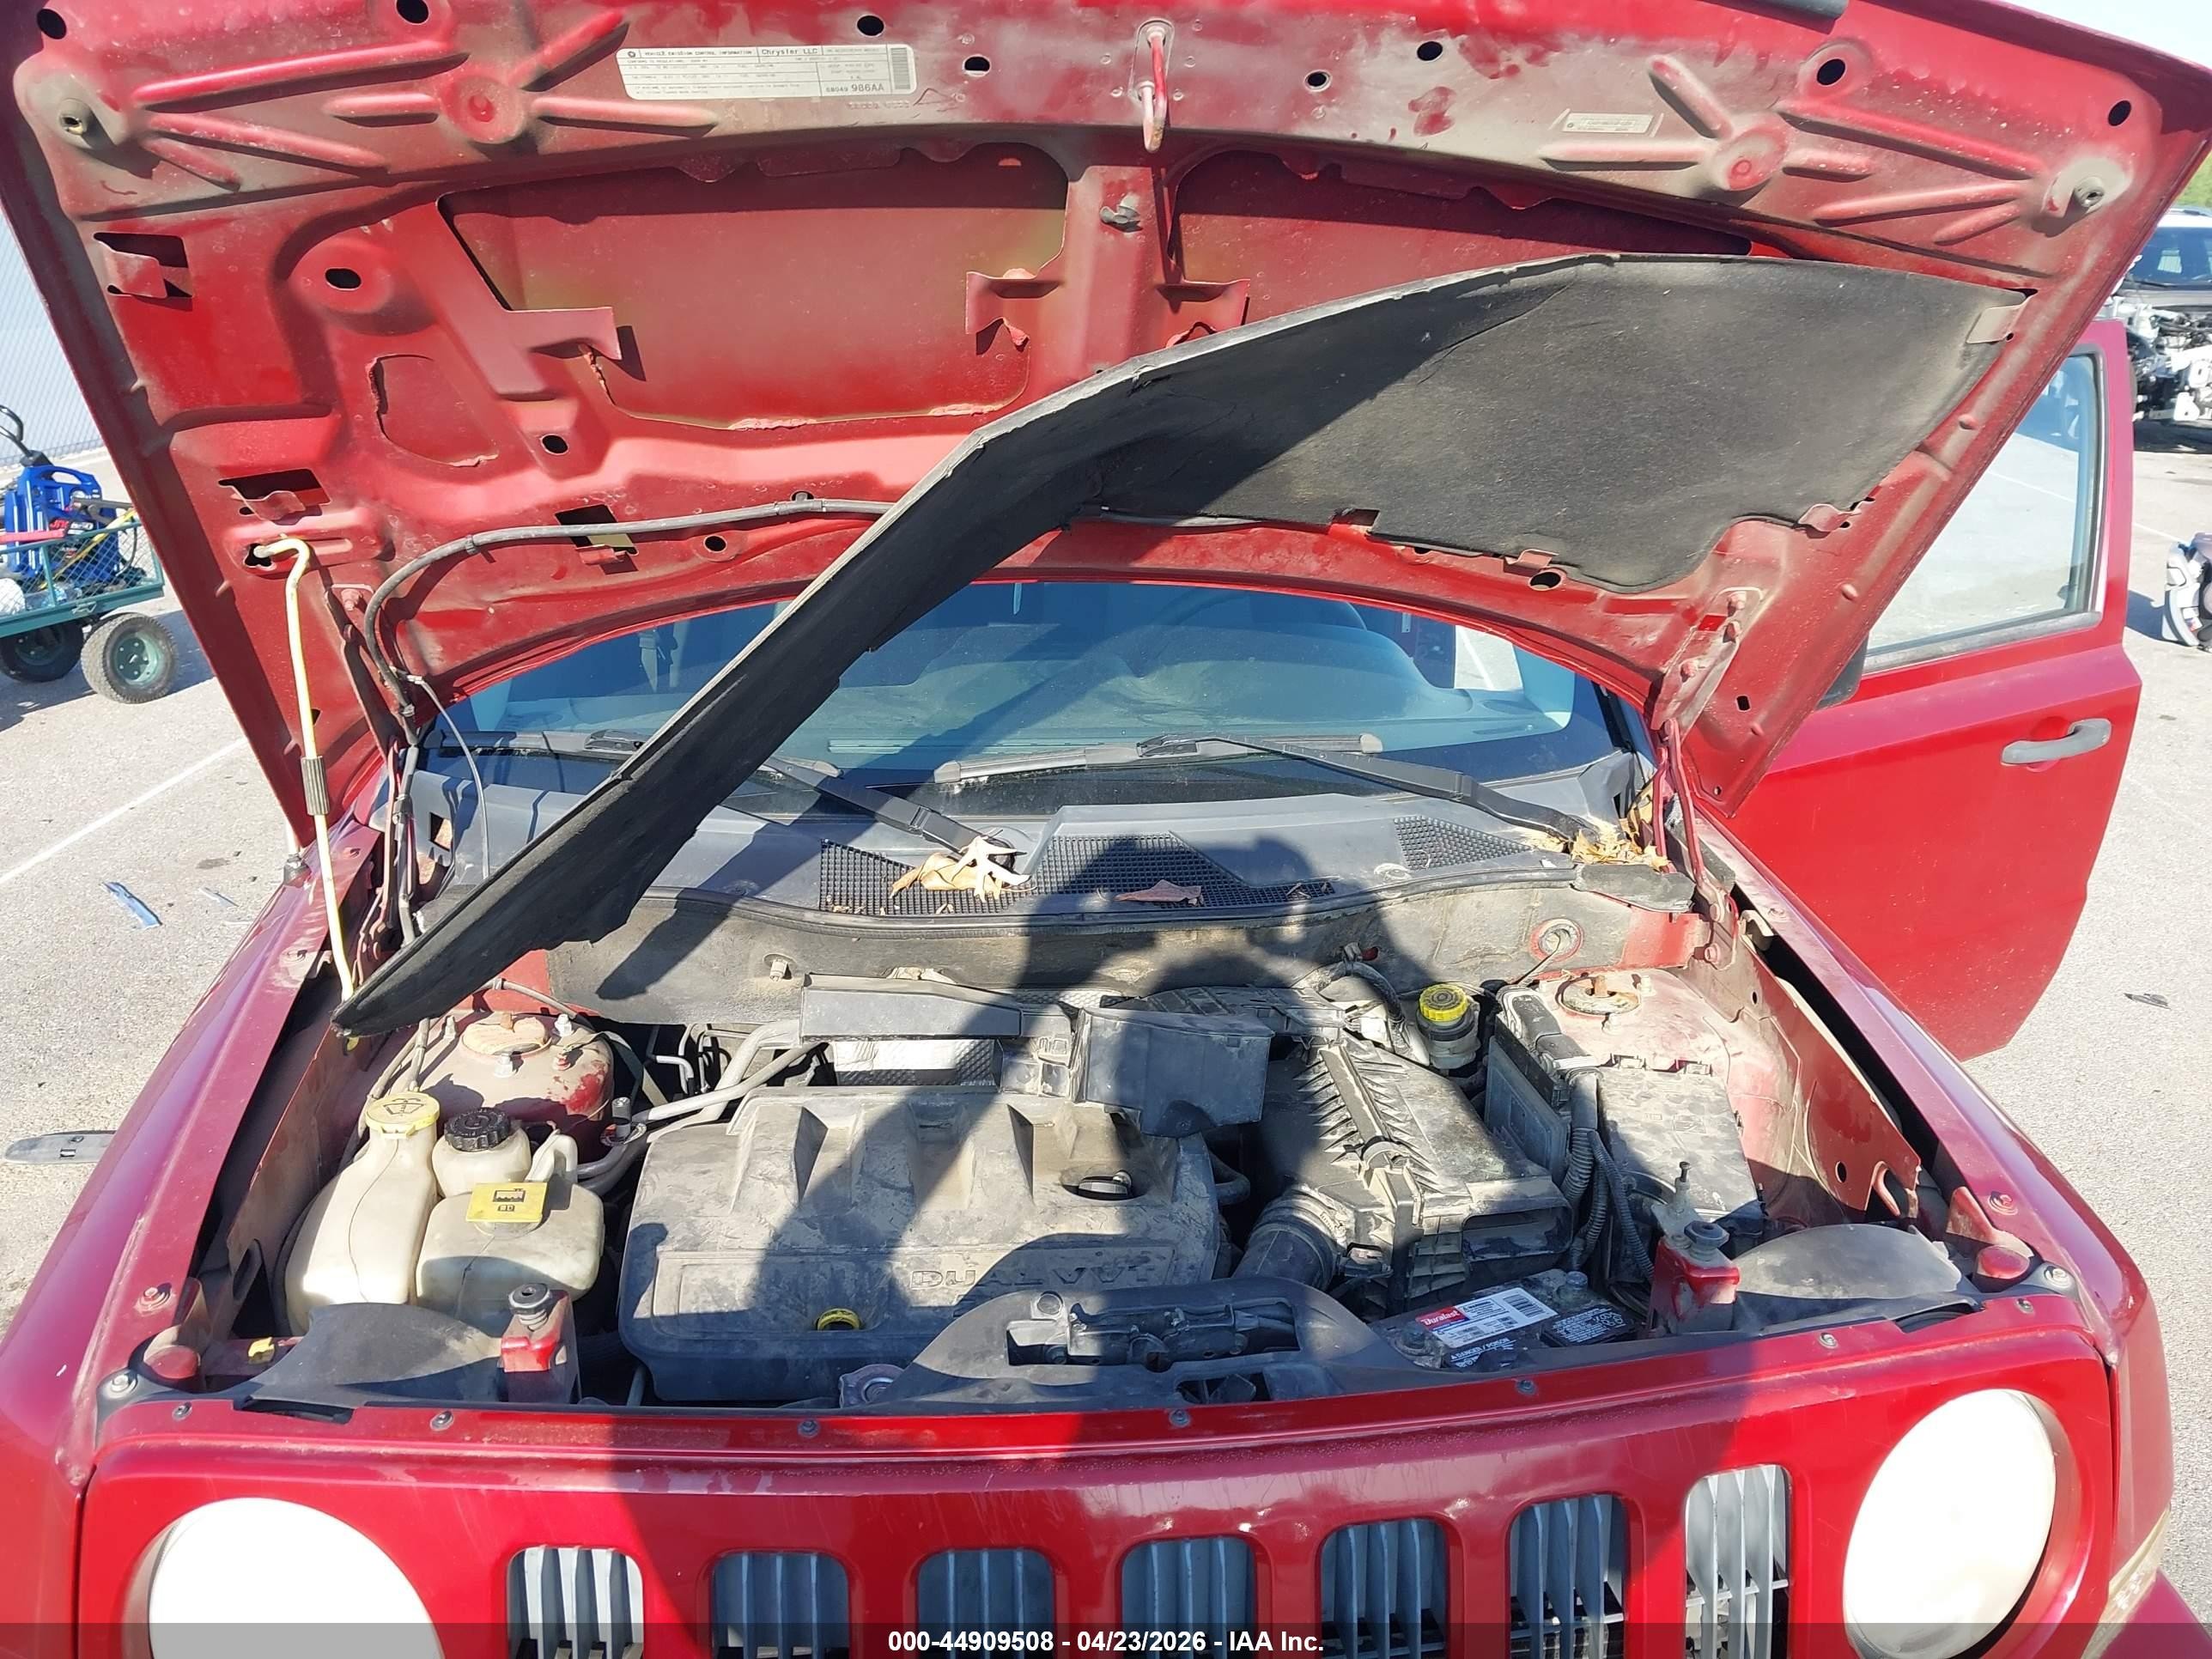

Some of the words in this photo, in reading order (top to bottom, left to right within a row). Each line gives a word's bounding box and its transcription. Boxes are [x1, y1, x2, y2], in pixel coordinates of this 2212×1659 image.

[762, 48, 799, 57] Chrysler
[851, 83, 884, 92] 986AA
[910, 1269, 1044, 1287] DUAL
[1420, 1310, 1461, 1326] Duralast
[1455, 1346, 1483, 1358] DANGER
